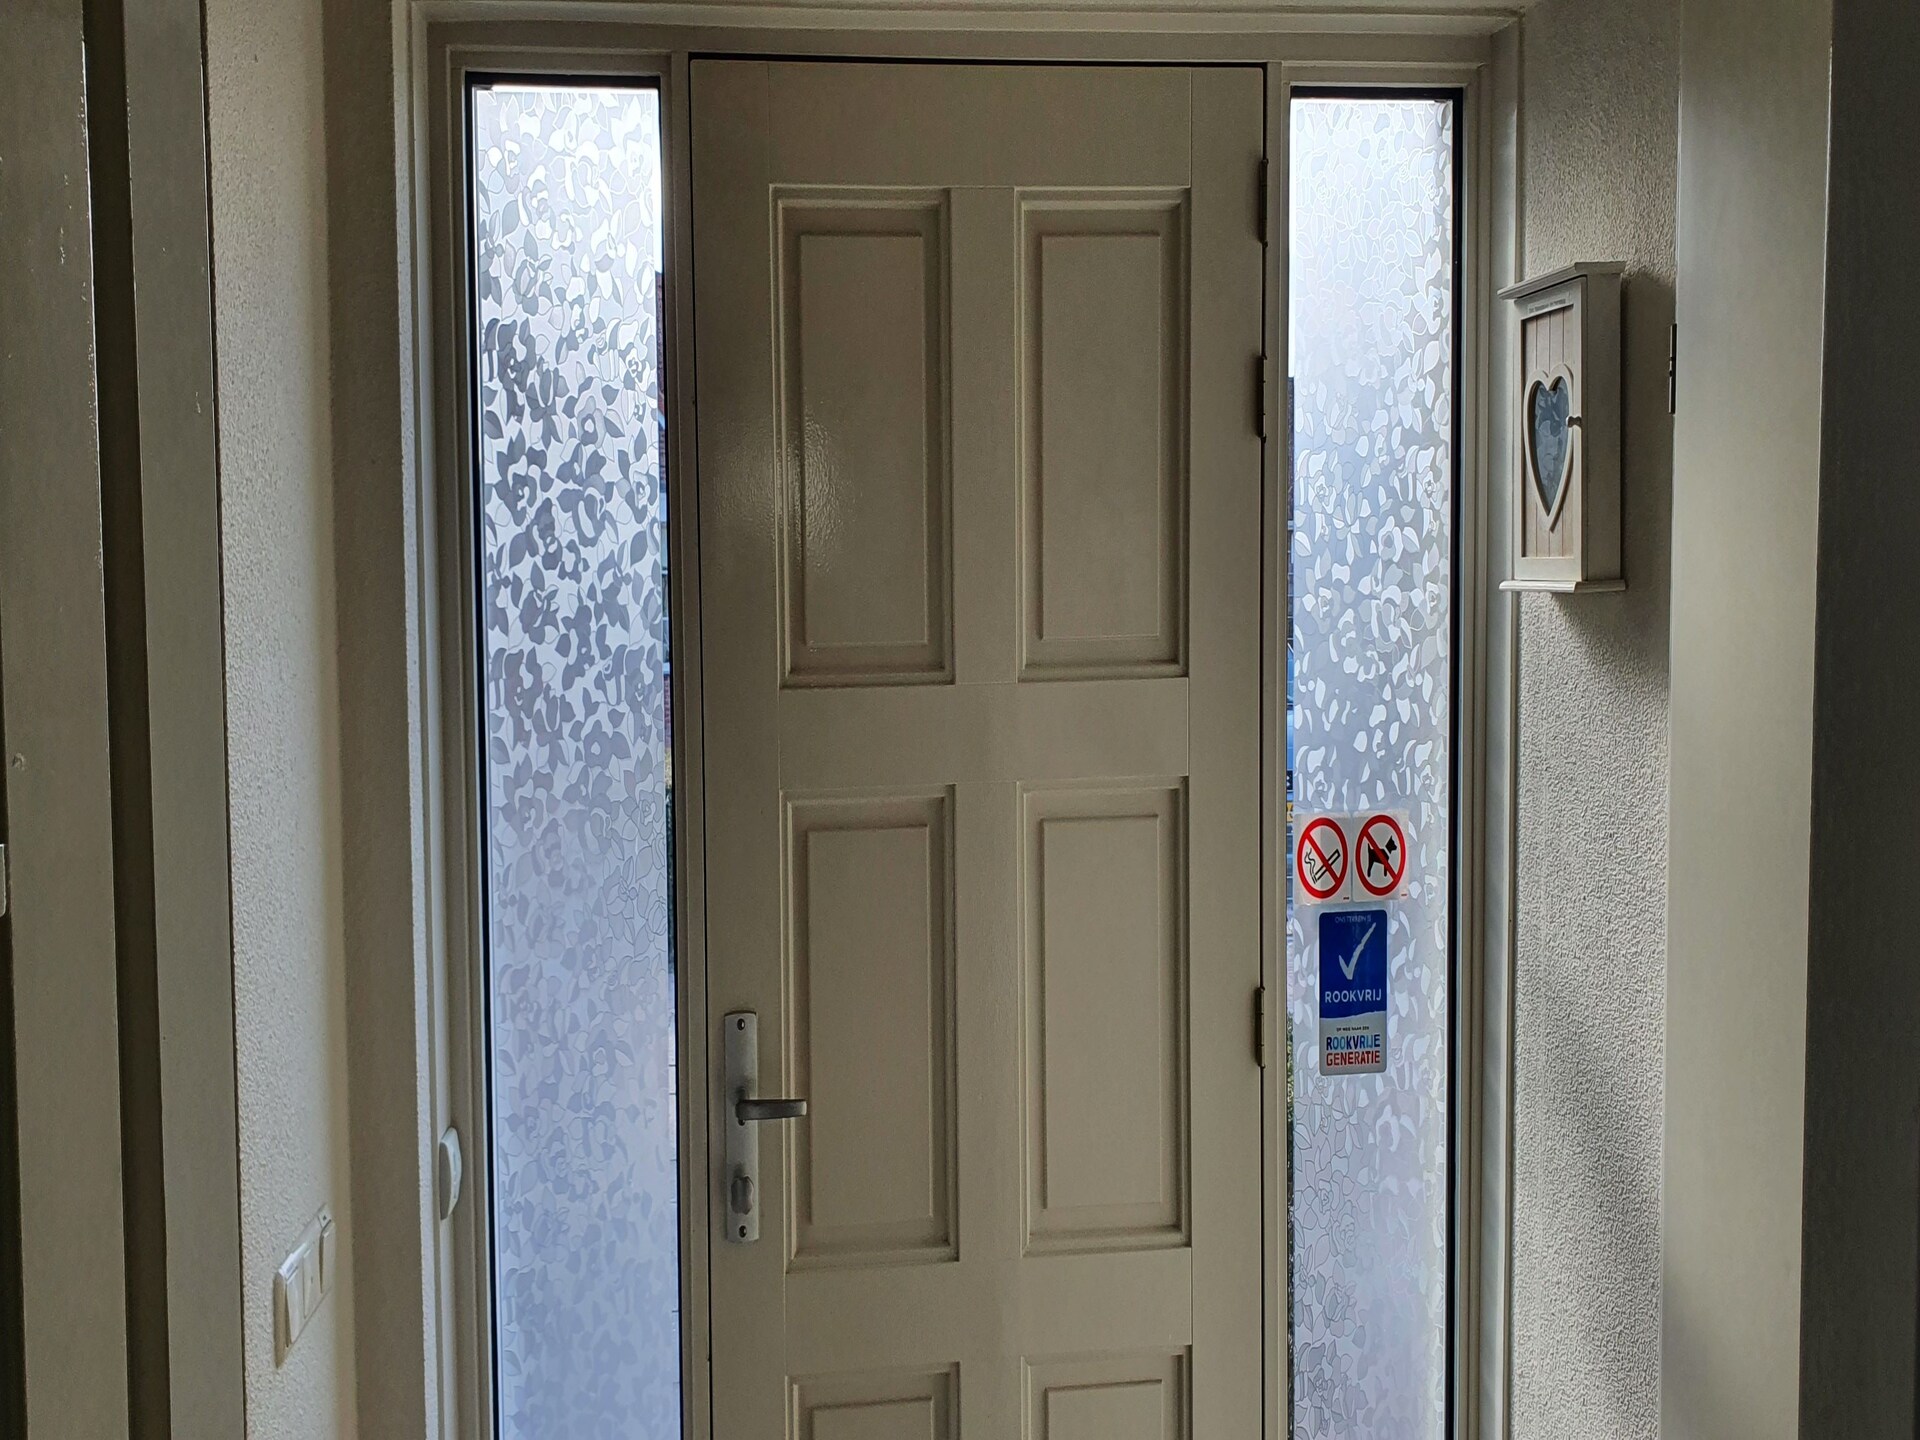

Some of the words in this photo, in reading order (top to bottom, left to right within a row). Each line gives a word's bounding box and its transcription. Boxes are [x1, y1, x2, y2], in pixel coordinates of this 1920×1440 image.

[1325, 988, 1382, 1003] ROOKVRIJ
[1326, 1033, 1381, 1051] ROOKVRIJE
[1326, 1050, 1380, 1067] GENERATIE
